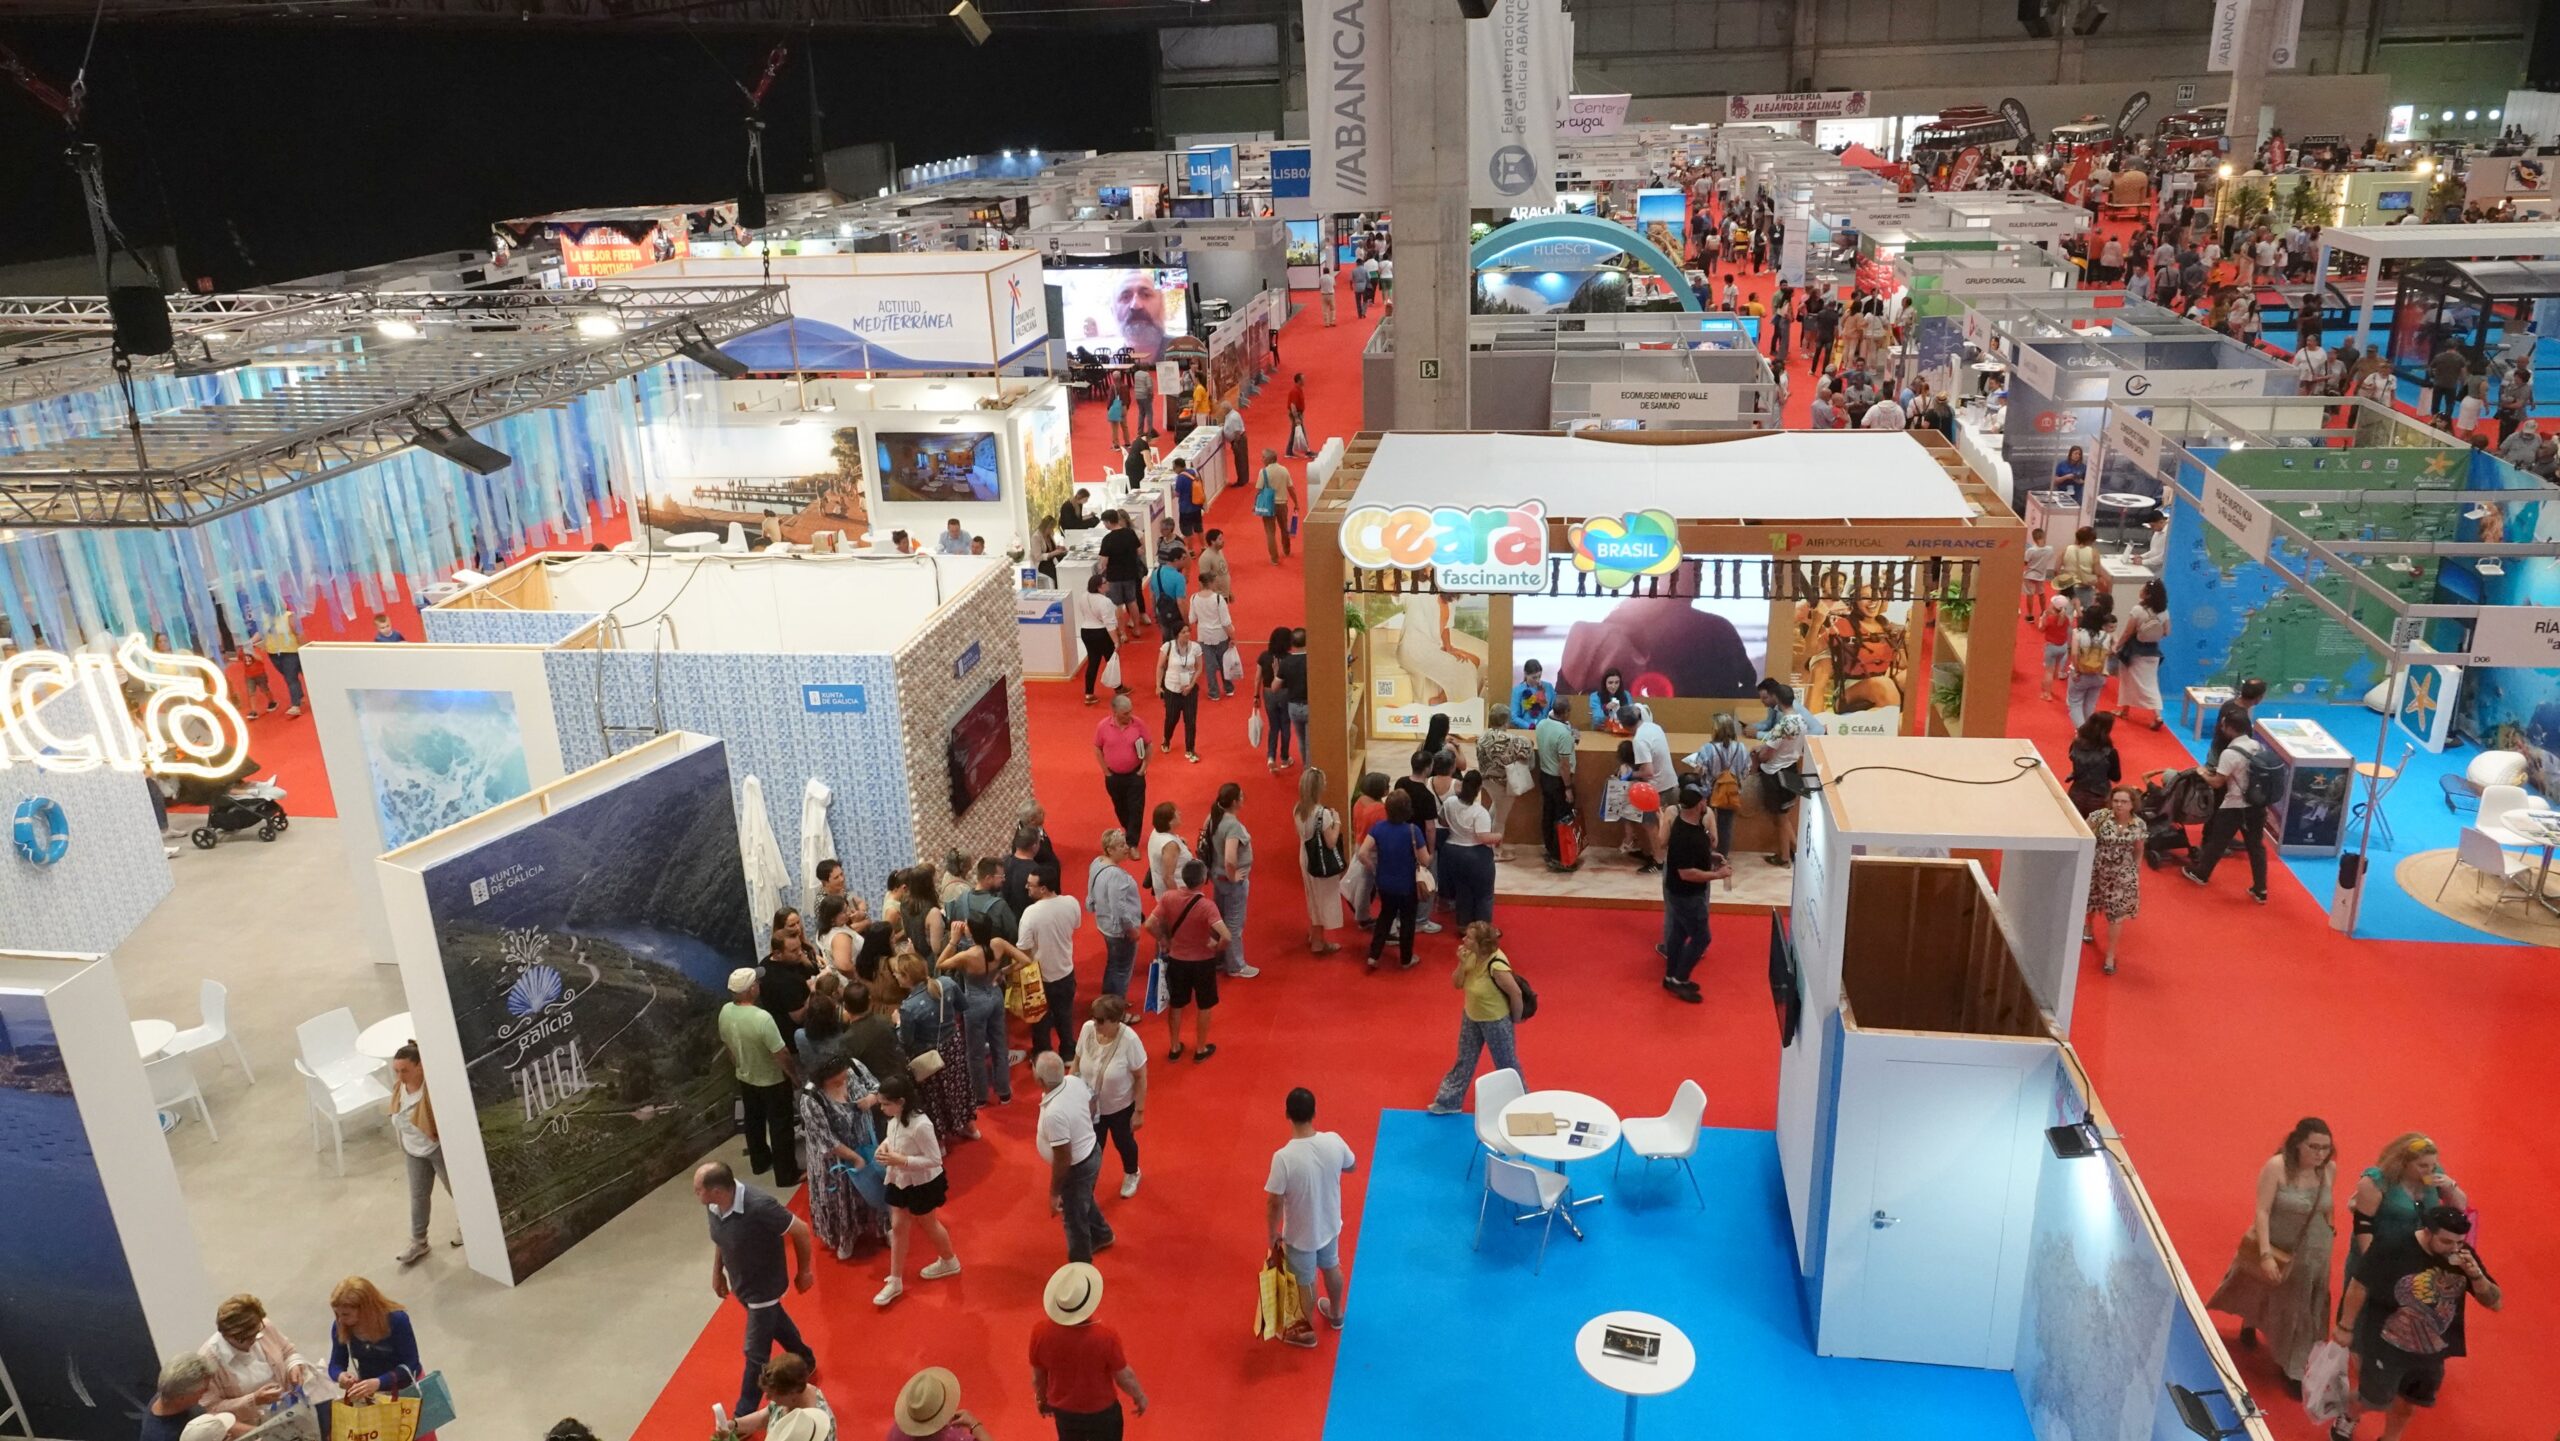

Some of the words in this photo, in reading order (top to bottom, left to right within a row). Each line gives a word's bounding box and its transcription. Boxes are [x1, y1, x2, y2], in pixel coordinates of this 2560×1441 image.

[1516, 0, 1529, 56] ABANC
[1515, 61, 1528, 109] Galicia
[1573, 102, 1617, 115] Center
[1753, 102, 1804, 112] ALEJANDRA
[1806, 100, 1842, 111] SALINAS
[1501, 100, 1513, 134] Feira
[1516, 112, 1527, 134] de
[1556, 116, 1605, 133] ortugal
[1190, 165, 1231, 177] LISA
[583, 250, 612, 262] MEJOR
[613, 250, 642, 261] FIESTA
[578, 265, 590, 275] DE
[878, 300, 921, 314] ACTITUD
[853, 311, 953, 333] MEDITERRÁNEA
[1621, 391, 1660, 400] ECOMUSEO
[1660, 391, 1688, 400] MINERO
[1688, 392, 1708, 400] VALLE
[1640, 402, 1650, 410] DE
[1344, 503, 1542, 566] ceará
[1769, 533, 1804, 551] TAP
[1596, 542, 1659, 558] BRASIL
[1442, 569, 1541, 586] fascinante
[1449, 715, 1472, 723] EARÁ
[1851, 723, 1885, 733] CEARÁ
[489, 863, 524, 885] XUNTA
[491, 882, 505, 896] DE
[506, 864, 545, 888] GALICIA
[509, 1010, 574, 1060] galicia
[521, 1039, 588, 1121] AUGA
